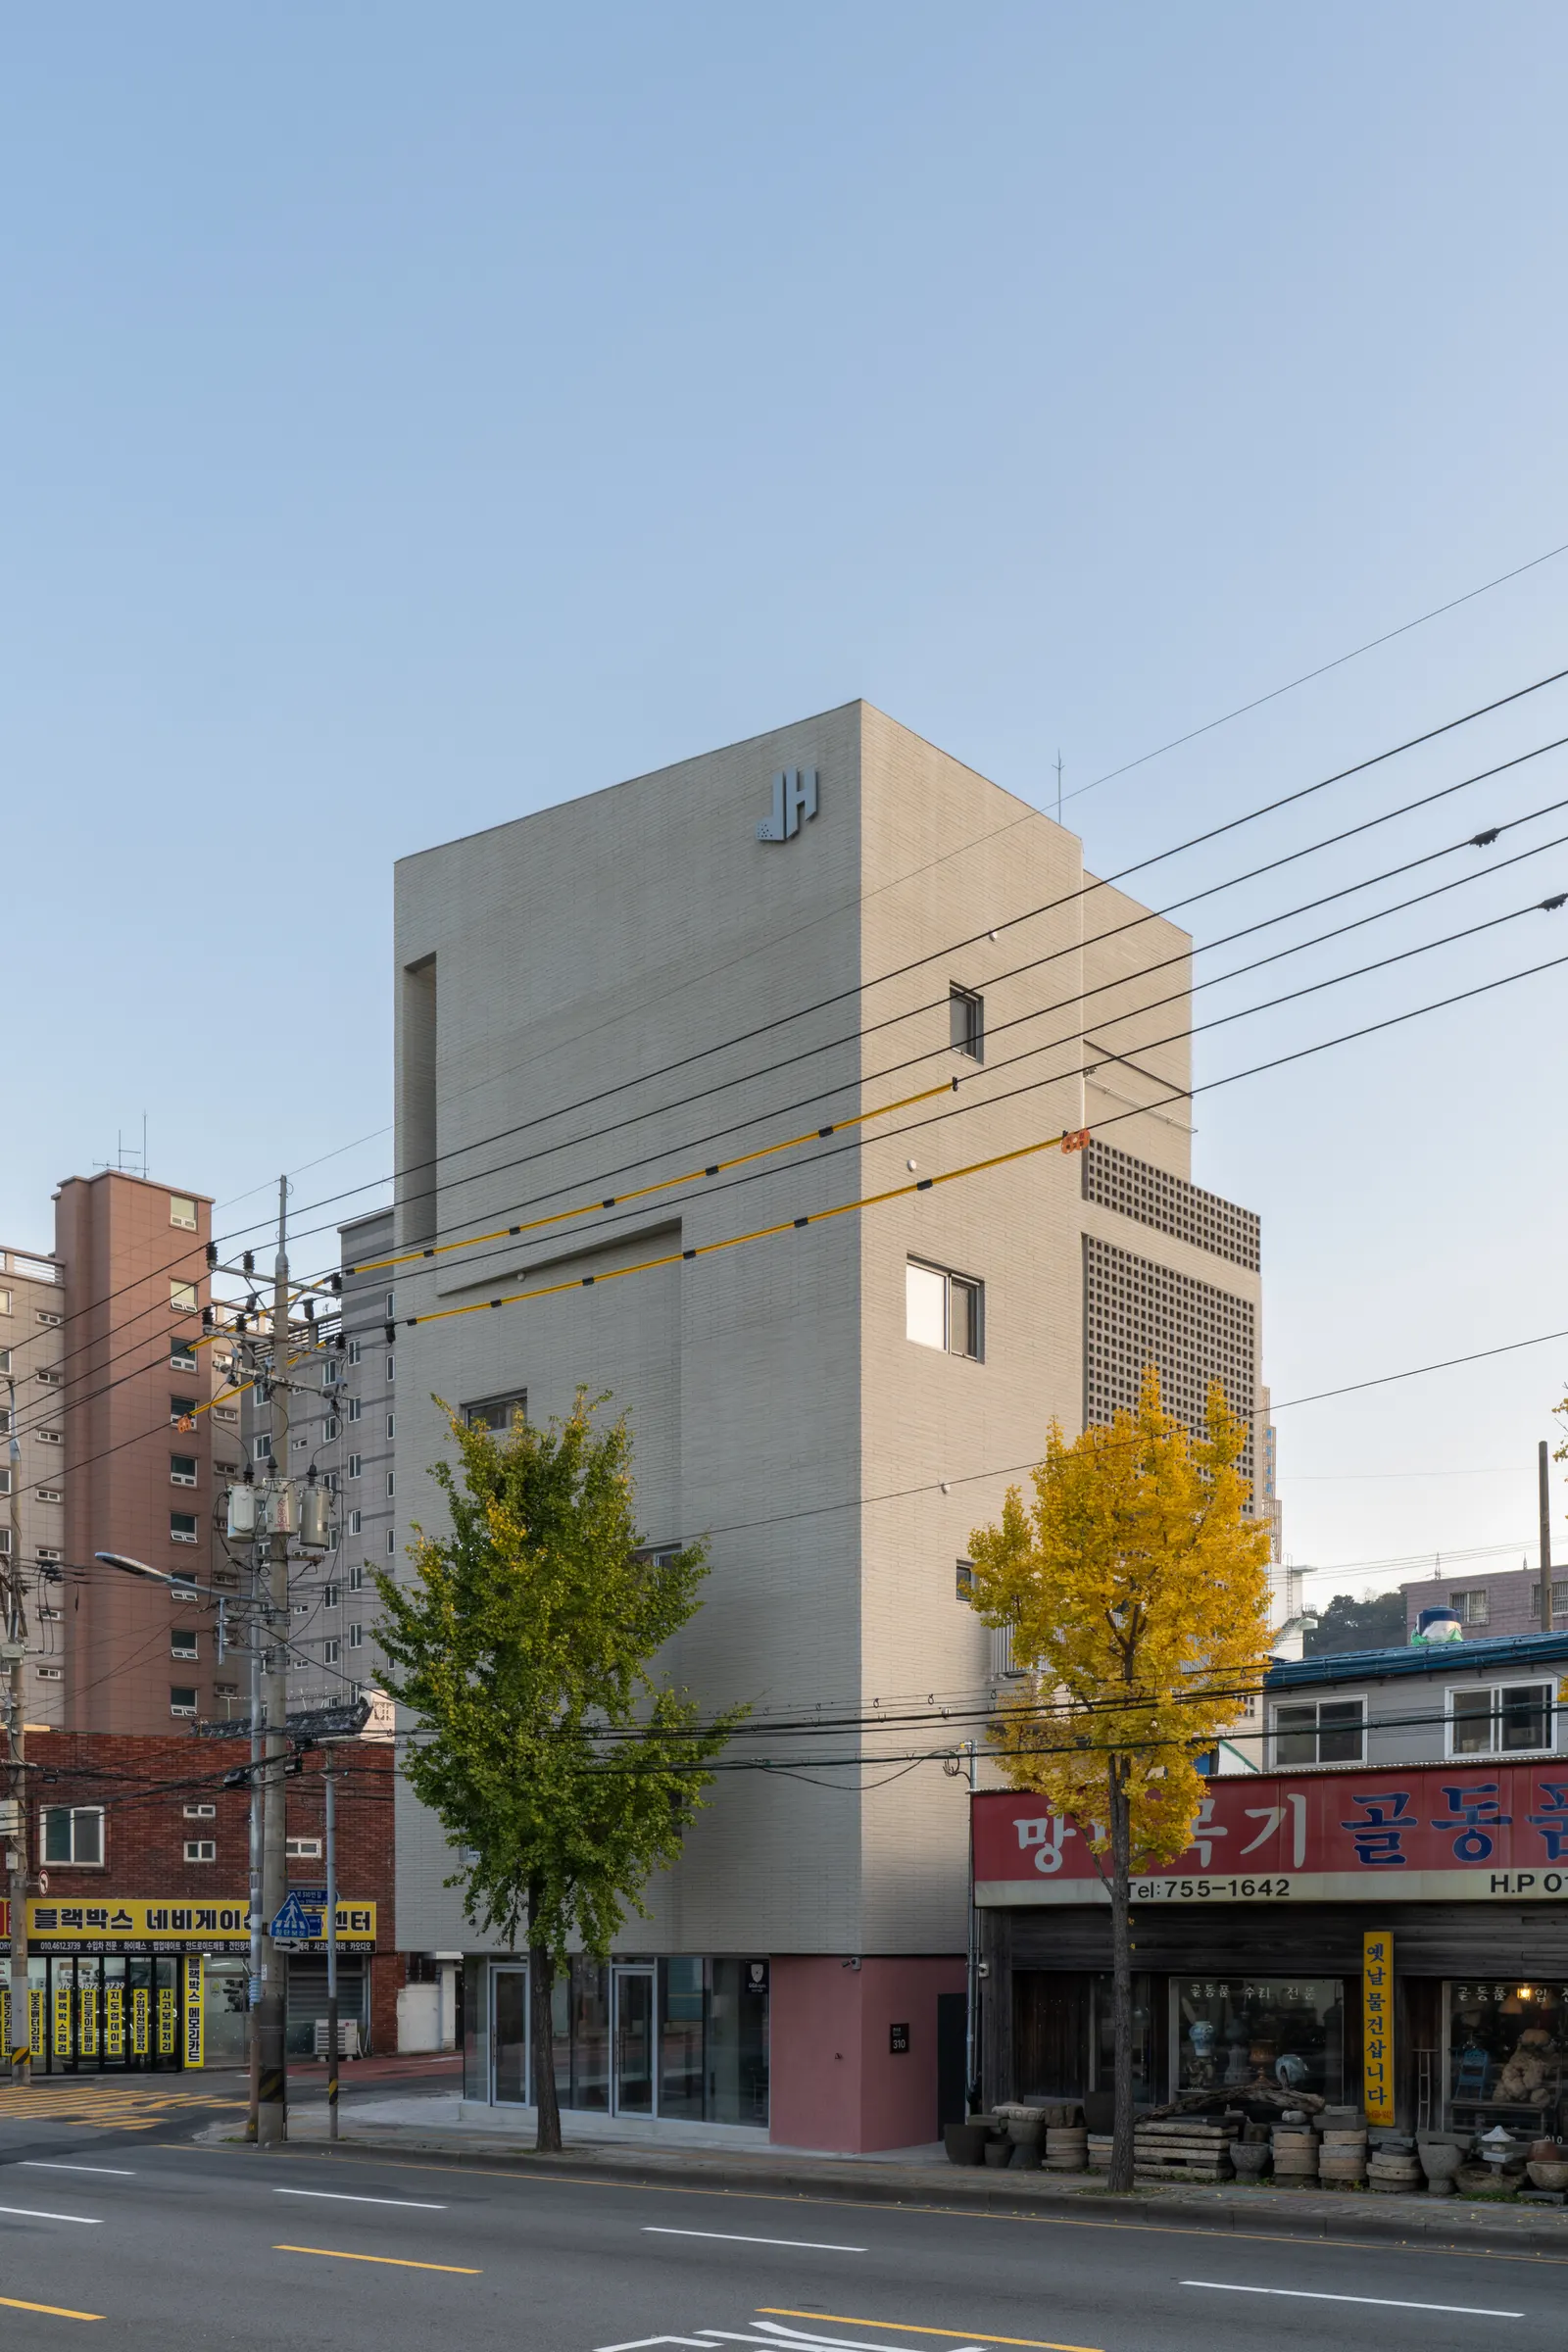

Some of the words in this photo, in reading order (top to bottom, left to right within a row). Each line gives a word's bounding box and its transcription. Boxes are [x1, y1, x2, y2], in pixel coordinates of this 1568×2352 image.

[756, 764, 817, 841] JH
[1012, 1793, 1306, 1874] 망목기
[1491, 1874, 1535, 1893] H.P
[34, 1908, 133, 1930] 블랙박스
[86, 1941, 104, 1951] 수입차
[105, 1941, 118, 1951] 전문
[188, 1958, 200, 2002] 블랙박스
[1190, 1984, 1230, 1998] 골동품
[1244, 1986, 1270, 1999] 수리
[1457, 1985, 1507, 2001] 골동품
[188, 2007, 200, 2062] 메모리카드
[893, 2039, 906, 2049] 310
